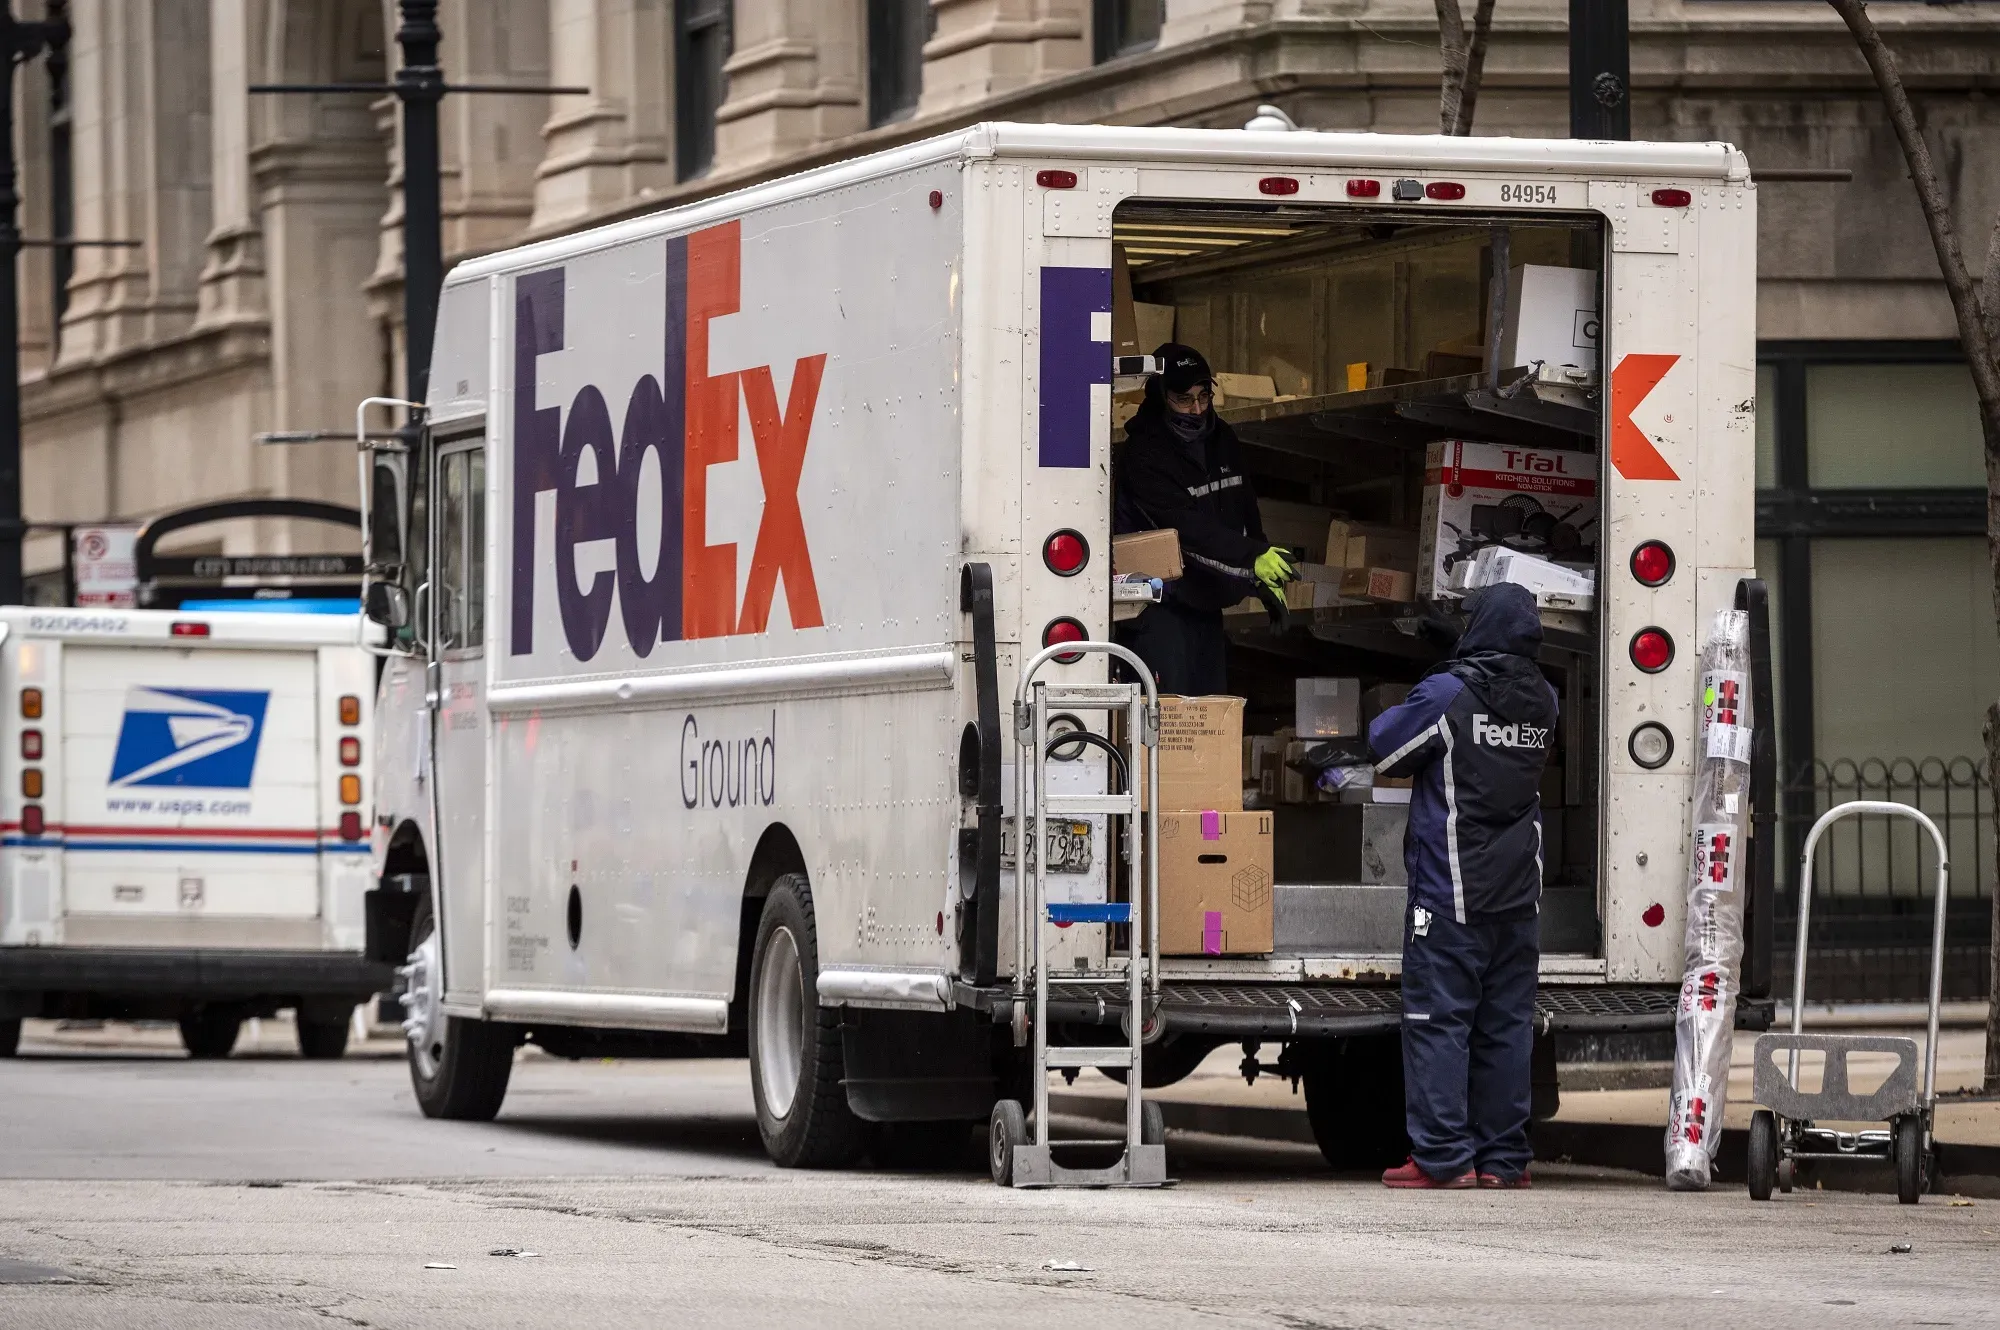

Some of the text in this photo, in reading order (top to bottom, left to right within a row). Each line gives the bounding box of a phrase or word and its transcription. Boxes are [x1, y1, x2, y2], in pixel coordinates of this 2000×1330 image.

[1501, 184, 1557, 204] 84954
[511, 218, 828, 662] FedEx
[1502, 450, 1568, 475] T-fal
[1495, 473, 1576, 488] KITCHEN SOLUTIONS
[1472, 713, 1549, 749] FedEx
[681, 709, 776, 809] Ground
[106, 799, 252, 816] www.usps.com
